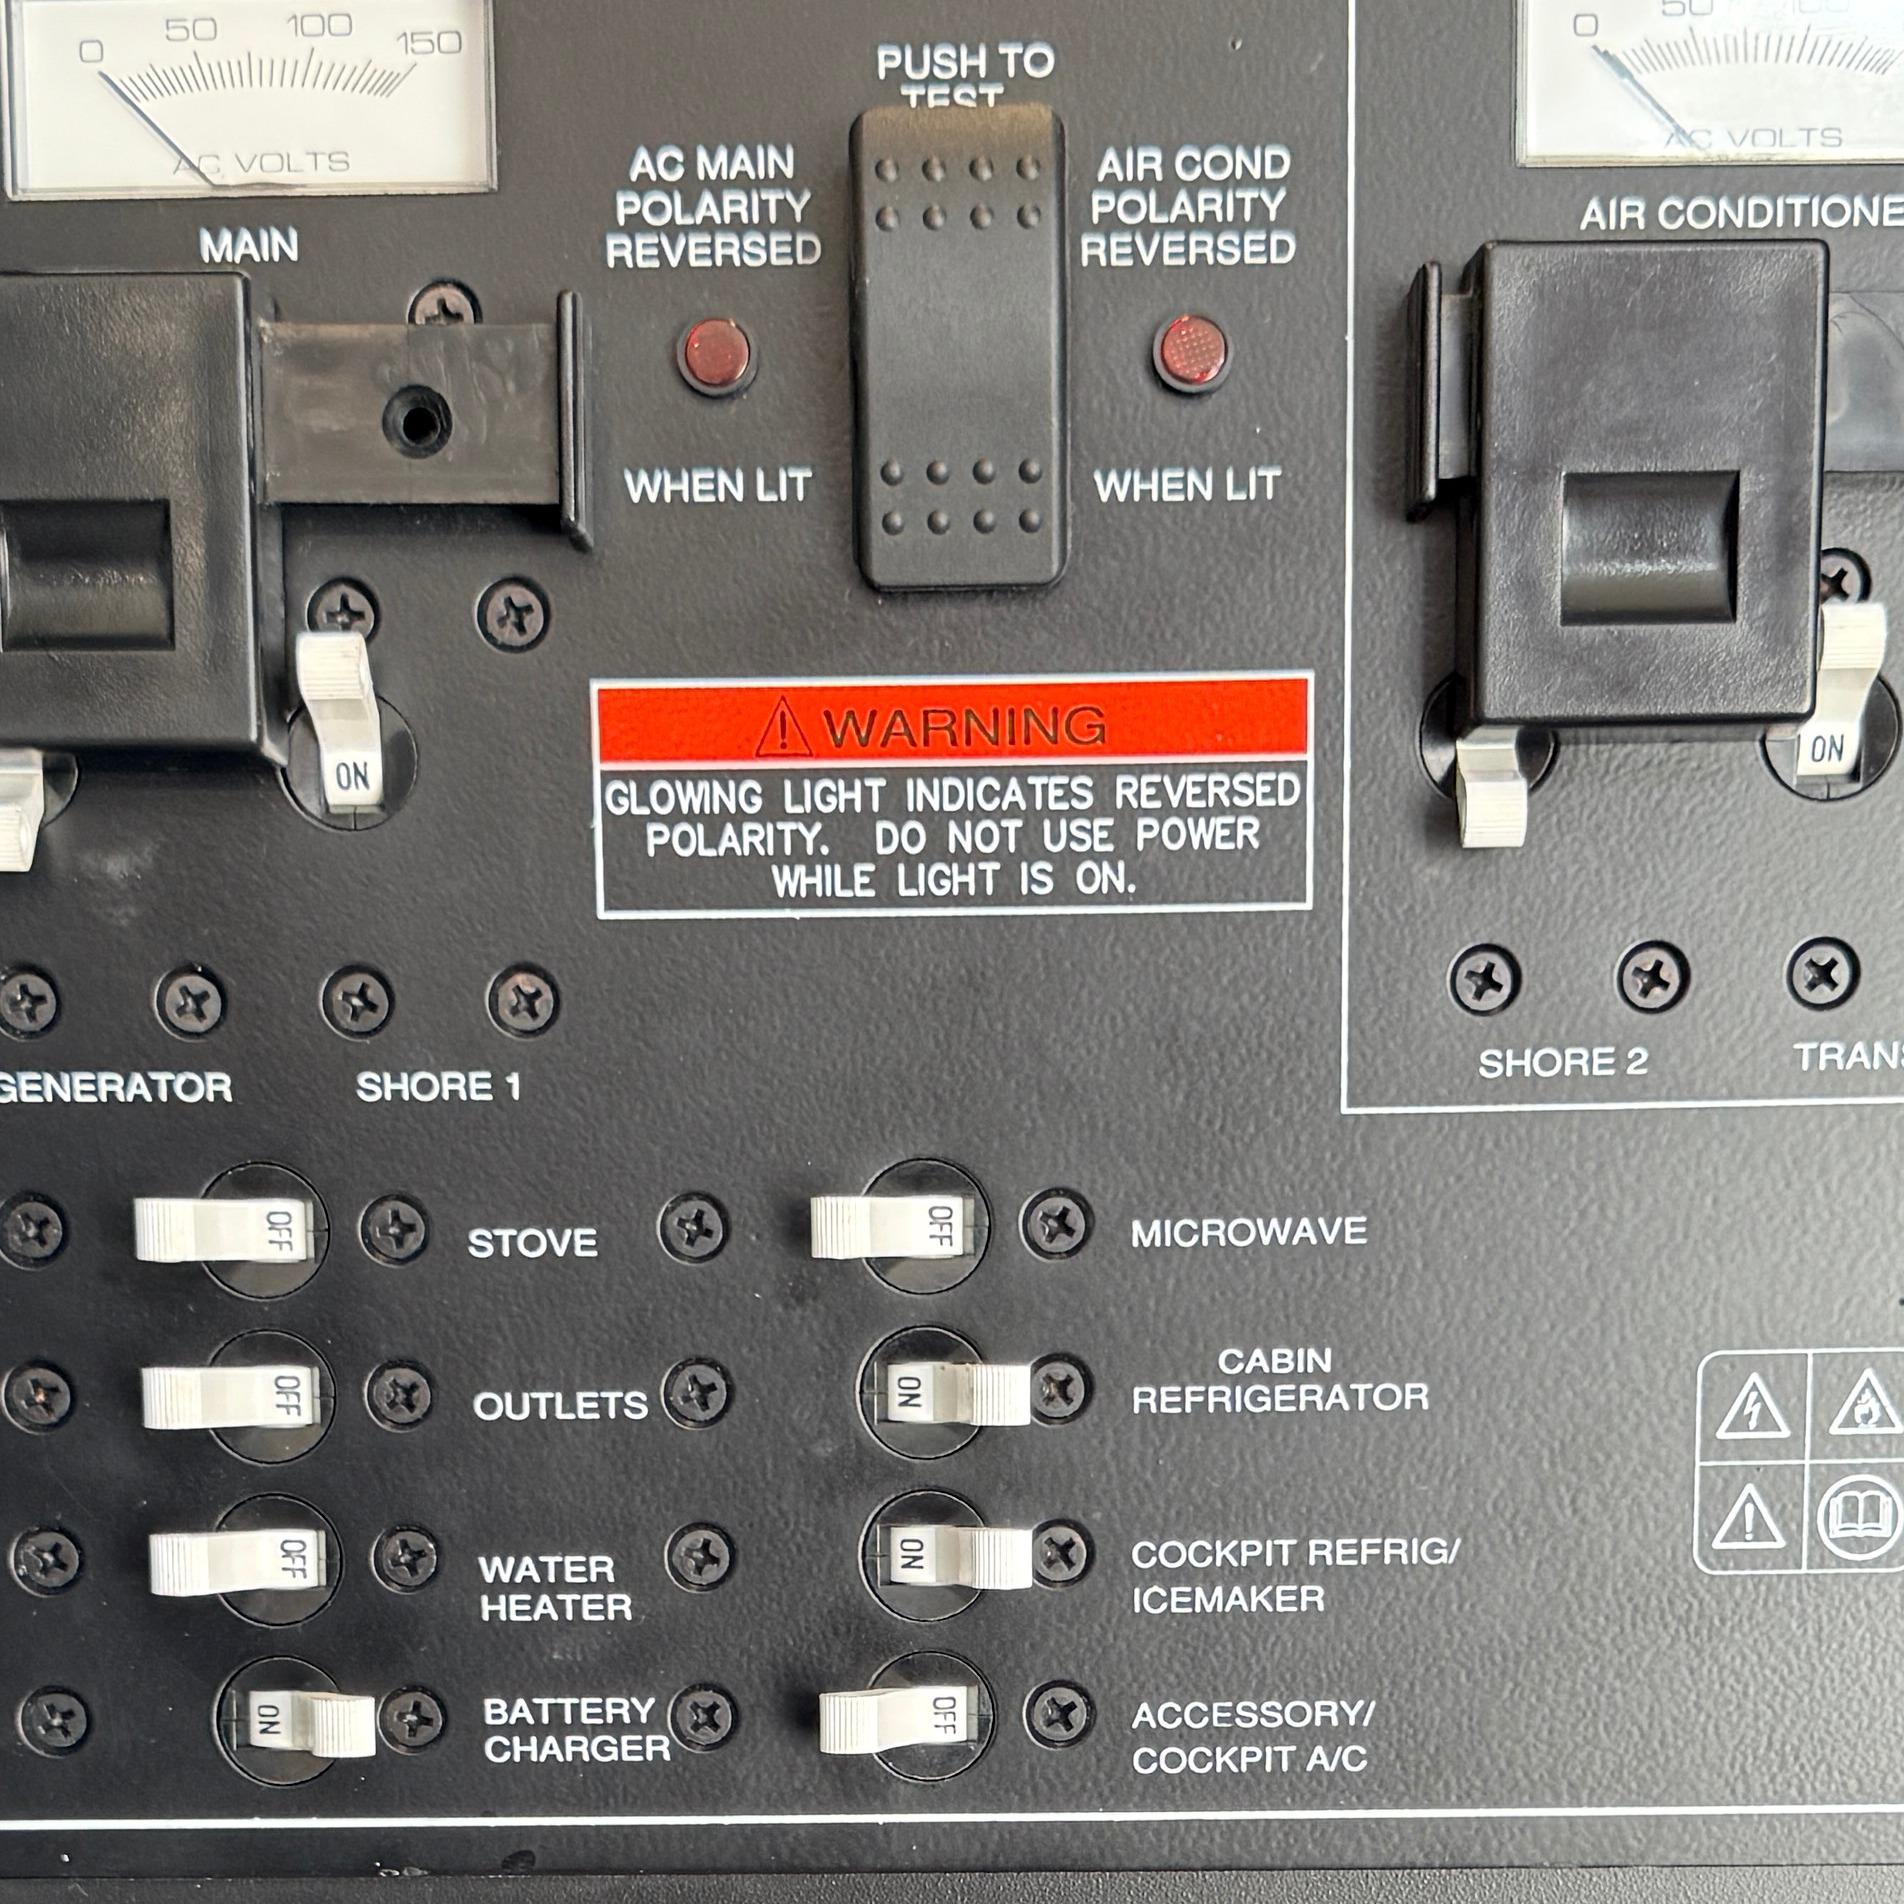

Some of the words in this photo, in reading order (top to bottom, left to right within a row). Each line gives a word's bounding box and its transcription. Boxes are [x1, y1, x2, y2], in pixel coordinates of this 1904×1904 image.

[165, 17, 217, 42] 50
[286, 13, 353, 38] 100
[78, 39, 104, 63] 0
[396, 30, 463, 55] 150
[877, 42, 986, 80] PUSH
[998, 42, 1055, 78] TO
[900, 83, 1004, 108] TEST
[1727, 127, 1842, 148] VOLTS
[235, 151, 350, 174] VOLTS
[630, 147, 684, 182] AC
[698, 145, 795, 180] MAIN
[1098, 148, 1162, 182] AIR
[1175, 146, 1291, 181] COND
[616, 189, 812, 226] POLARITY
[1092, 190, 1288, 225] POLARITY
[1580, 198, 1645, 231] AIR
[199, 227, 298, 262] MAIN
[606, 232, 822, 269] REVERSED
[1081, 231, 1295, 268] REVERSED
[624, 468, 743, 503] WHEN
[757, 468, 813, 502] LIT
[1094, 468, 1214, 502] WHEN
[1227, 467, 1282, 500] LIT
[823, 705, 1107, 750] WARNING
[1810, 735, 1845, 764] ON
[335, 761, 371, 792] ON
[605, 778, 763, 815] GLOWING
[785, 778, 886, 814] LIGHT
[906, 775, 1095, 812] INDICATES
[1115, 771, 1301, 809] REVERSED
[647, 822, 829, 857] POLARITY.
[876, 820, 927, 855] DO
[948, 820, 1023, 854] NOT
[1043, 818, 1114, 853] USE
[1136, 816, 1260, 852] POWER
[771, 863, 875, 899] WHILE
[897, 863, 1000, 897] LIGHT
[1019, 862, 1054, 896] IS
[1075, 861, 1136, 895] ON.
[1479, 1049, 1615, 1079] SHORE
[1626, 1047, 1649, 1077] 2
[356, 1072, 492, 1102] SHORE
[506, 1072, 520, 1101] 1
[265, 1210, 293, 1252] OFF
[468, 1228, 599, 1258] STOVE
[1132, 1217, 1367, 1248] MICROWAVE
[1218, 1349, 1332, 1375] CABIN
[274, 1374, 300, 1417] OFF
[473, 1392, 649, 1421] OUTLETS
[898, 1376, 922, 1408] ON
[1133, 1383, 1430, 1414] REFRIGERATOR
[280, 1538, 306, 1580] OFF
[900, 1538, 924, 1570] ON
[1131, 1540, 1297, 1570] COCKPIT
[1308, 1537, 1461, 1568] REFRIG/
[478, 1556, 614, 1585] WATER
[480, 1594, 632, 1622] HEATER
[1133, 1586, 1325, 1614] ICEMAKER
[258, 1704, 280, 1736] ON
[484, 1698, 656, 1727] BATTERY
[1132, 1701, 1376, 1730] ACCESSORY/
[484, 1735, 670, 1764] CHARGER
[1132, 1746, 1296, 1775] COCKPIT
[1307, 1745, 1368, 1774] A/C
